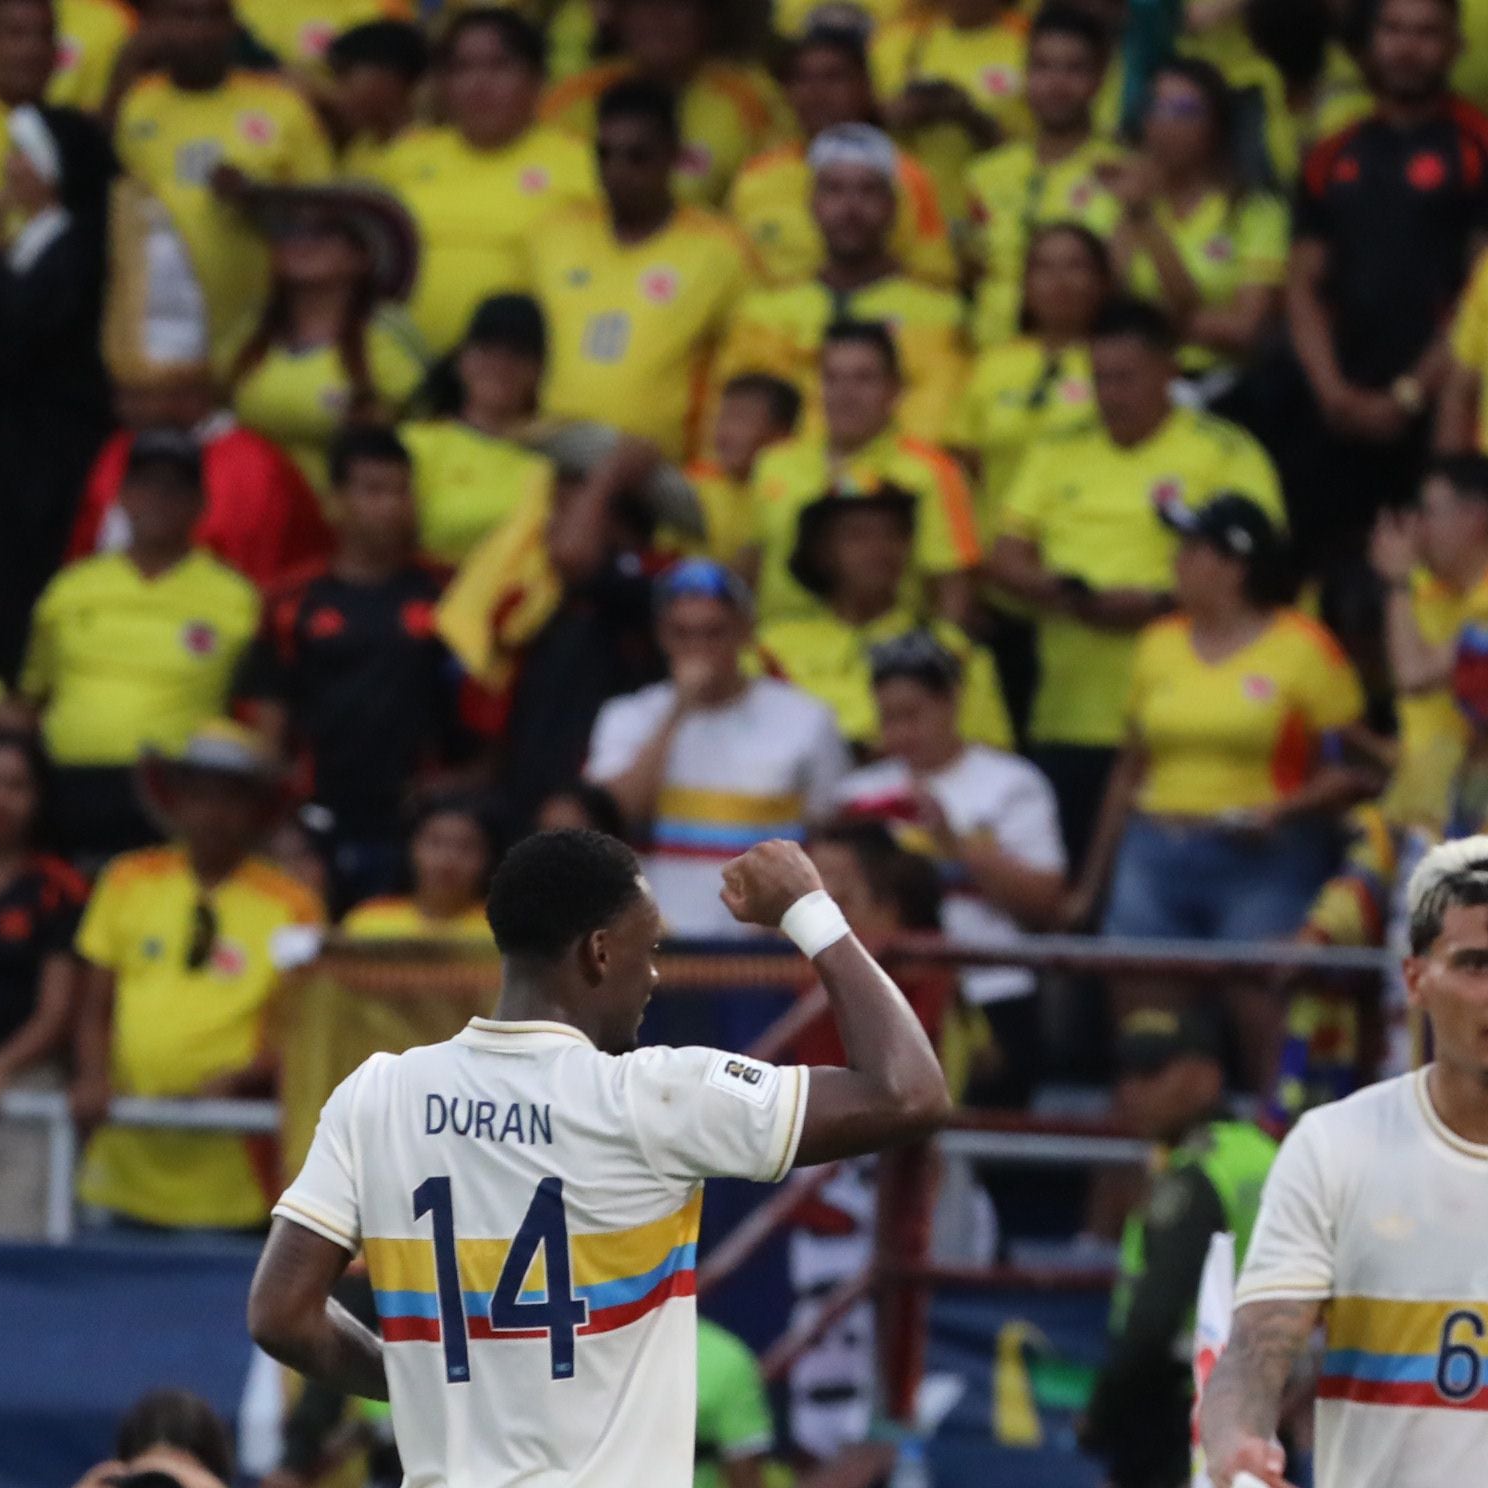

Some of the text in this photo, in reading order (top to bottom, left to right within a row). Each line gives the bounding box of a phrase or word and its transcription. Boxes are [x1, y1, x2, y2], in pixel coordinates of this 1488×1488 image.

[425, 1093, 553, 1145] DURAN
[413, 1175, 589, 1384] 14
[1436, 1309, 1486, 1399] 6
